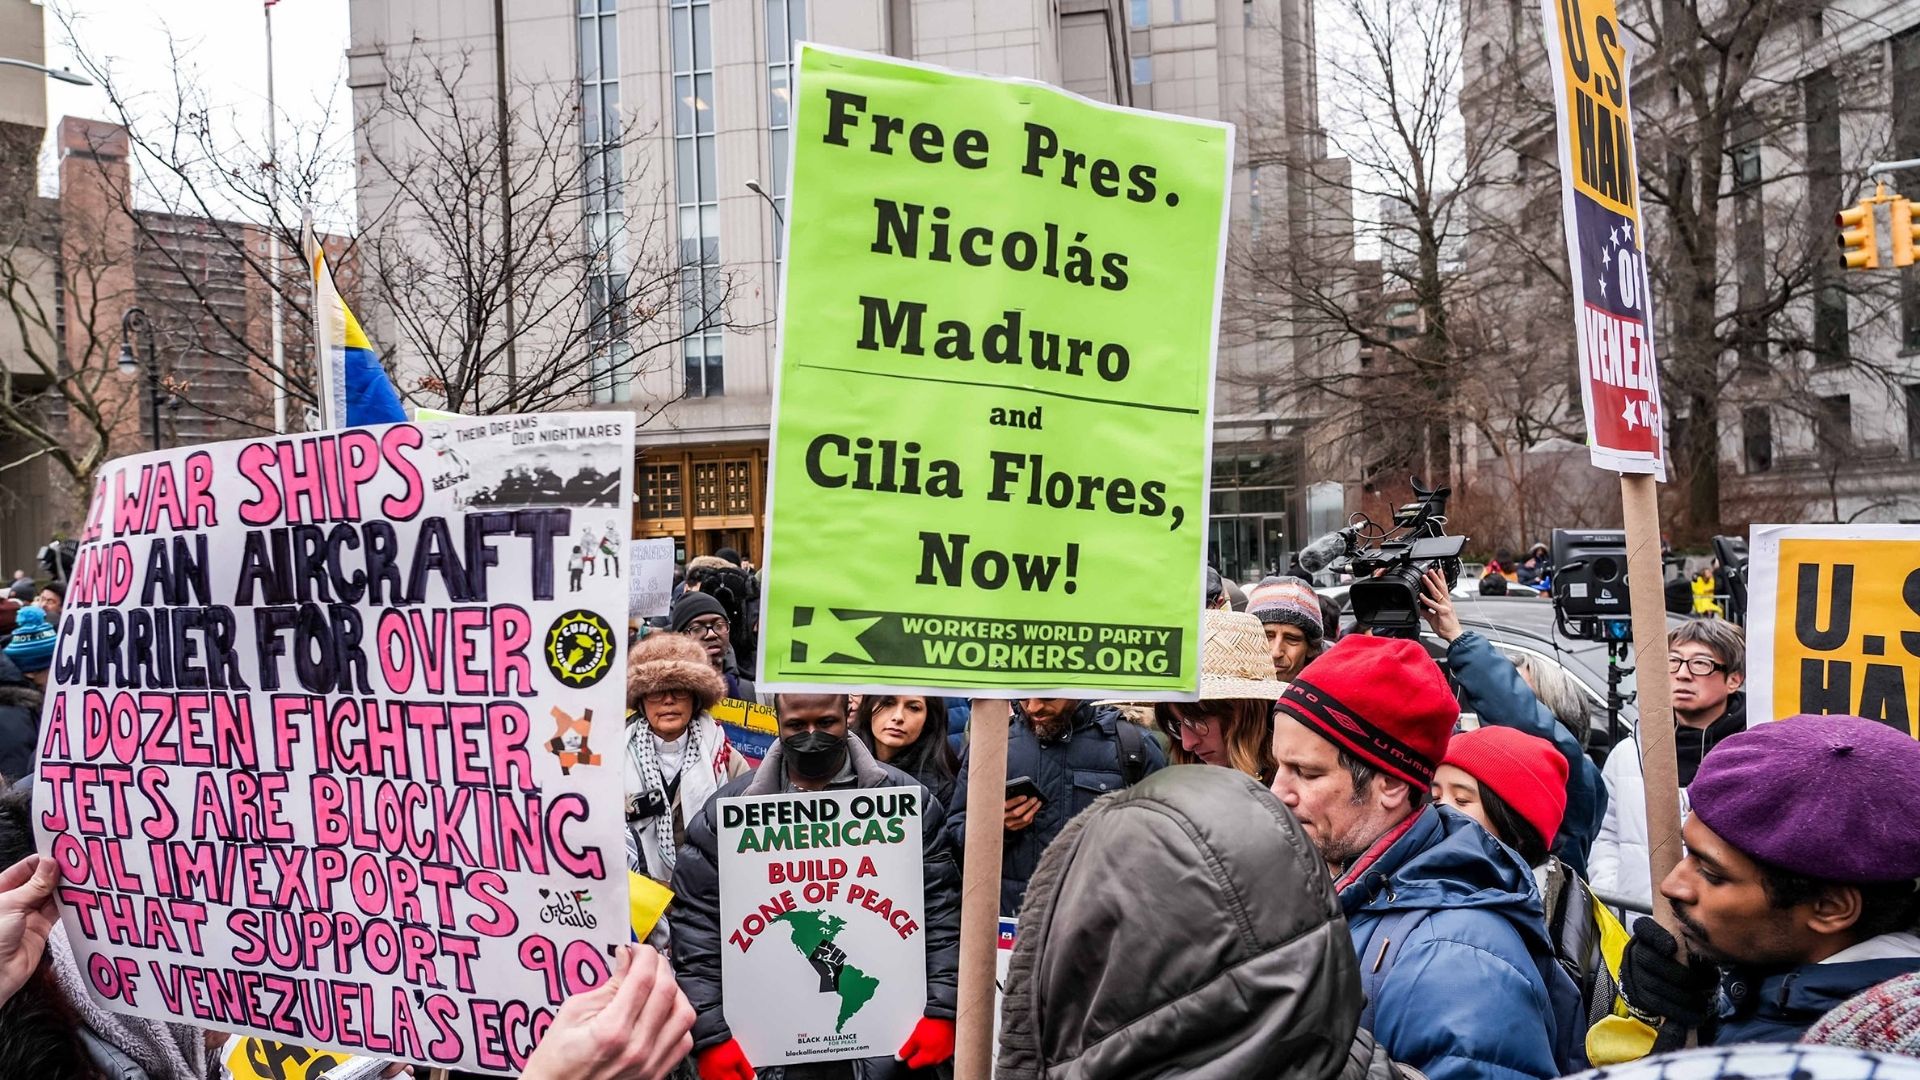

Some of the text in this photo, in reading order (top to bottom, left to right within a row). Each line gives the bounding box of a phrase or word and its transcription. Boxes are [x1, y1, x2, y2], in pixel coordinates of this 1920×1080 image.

[823, 89, 1180, 207] Free Pres.
[870, 198, 1129, 292] Nicolás
[856, 295, 1130, 382] Maduro
[455, 416, 538, 442] THEIR DREAMS
[512, 424, 622, 446] OUR NIGHTMARES
[989, 406, 1043, 430] and
[112, 449, 219, 538] WAR
[237, 423, 425, 528] SHIPS
[805, 433, 1185, 532] Cilia Flores,
[65, 508, 573, 609] AND AN AIRCRAFT
[915, 531, 1080, 595] Now!
[54, 602, 539, 697] CARRIER FOR OVER
[902, 616, 1171, 646] WORKERS WORLD PARTY
[922, 639, 1169, 674] WORKERS.ORG
[721, 699, 745, 710] CILIA
[41, 689, 543, 794] A DOZEN FIGHTER
[40, 760, 607, 881] JETS ARE BLOCKING
[722, 792, 919, 829] DEFEND OUR
[736, 816, 907, 854] AMERICAS
[50, 832, 520, 938] OIL IM/EXPORTS
[767, 855, 879, 885] BUILD A
[57, 885, 618, 1006] THAT SUPPORT 90
[727, 881, 920, 954] ZONE OF PEACE
[87, 951, 141, 1008] OF
[147, 959, 465, 1065] VENEZUELA'S
[797, 1034, 857, 1045] BLACK ALLIANCE
[785, 1044, 870, 1057] blackallianceforpeace.com
